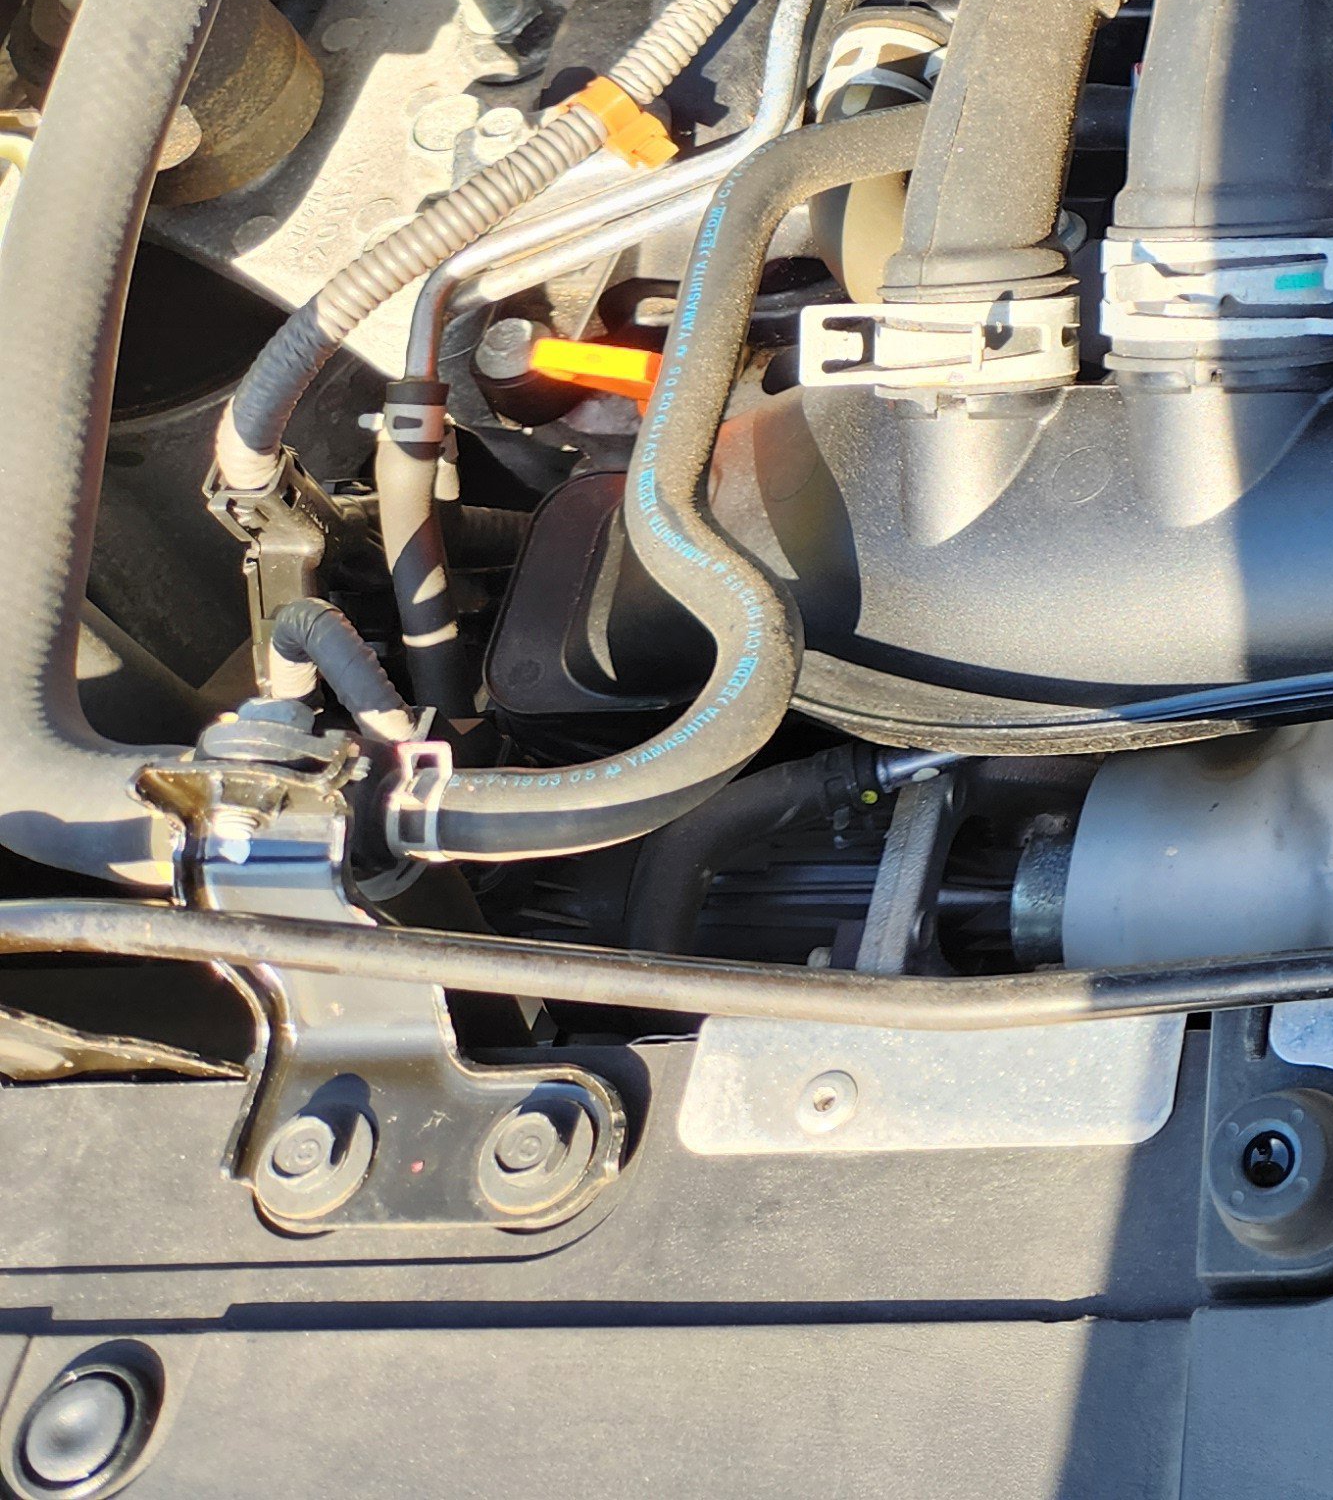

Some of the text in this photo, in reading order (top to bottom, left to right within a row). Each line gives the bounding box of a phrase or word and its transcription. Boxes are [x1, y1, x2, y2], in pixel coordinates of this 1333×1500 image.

[677, 259, 709, 346] YAMASHITA
[649, 514, 710, 569] YAMASHITA
[626, 706, 721, 768] YAMASHITA
